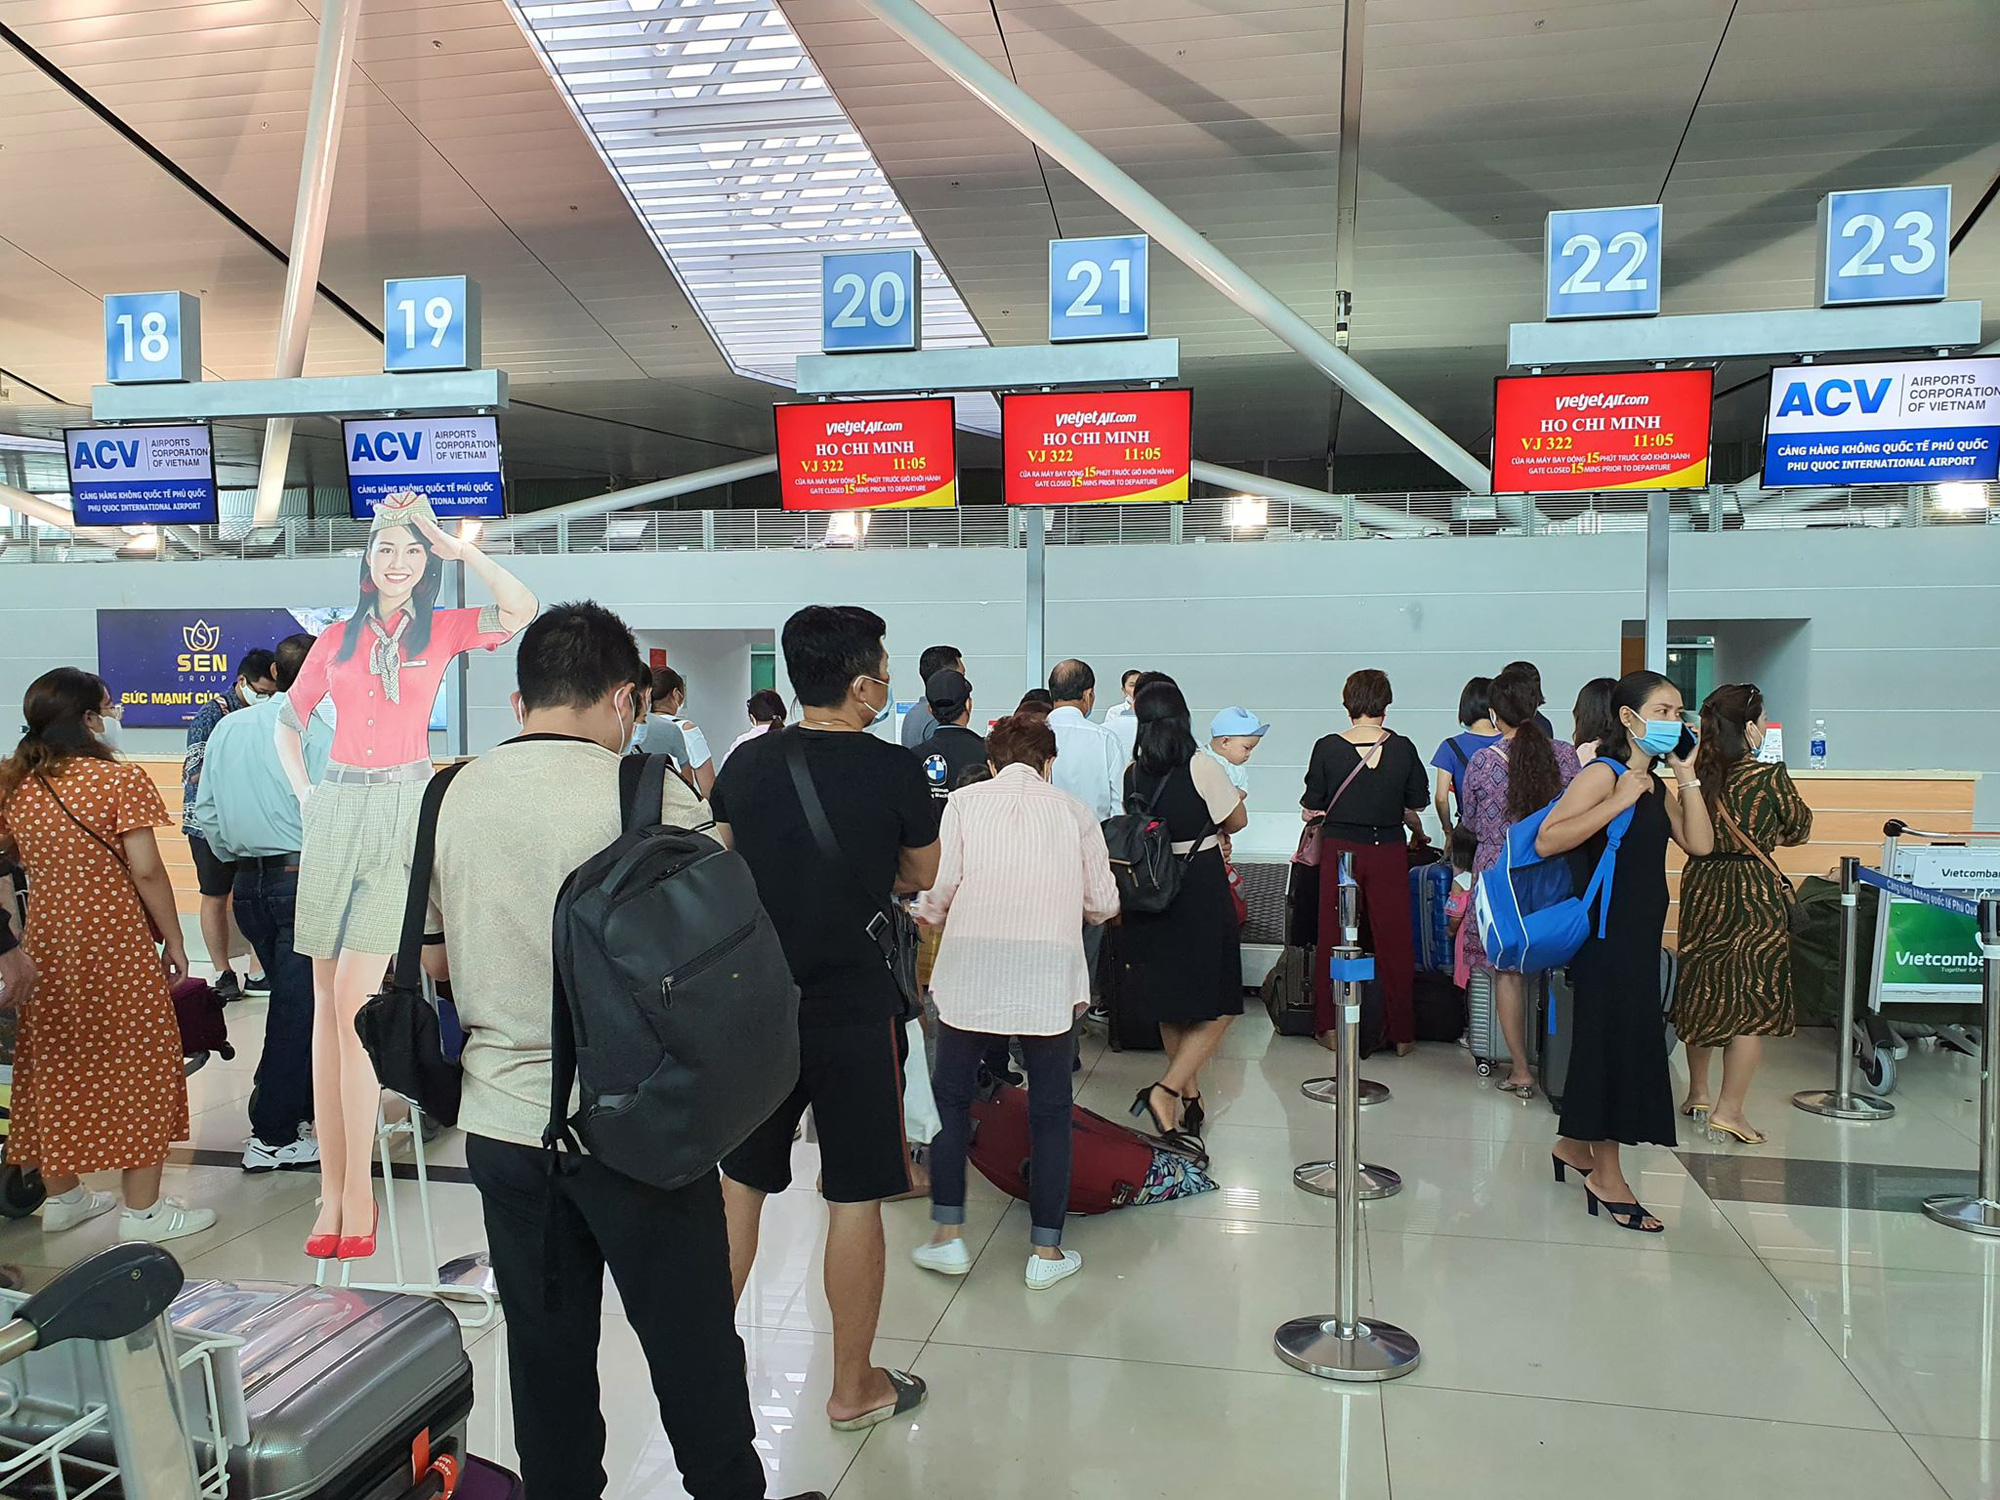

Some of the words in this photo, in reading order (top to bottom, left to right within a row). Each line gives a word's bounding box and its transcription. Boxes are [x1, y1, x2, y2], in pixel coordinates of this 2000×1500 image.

[1838, 210, 1936, 277] 23
[1559, 231, 1649, 294] 22
[1065, 259, 1132, 317] 21
[831, 271, 905, 328] 20
[397, 297, 453, 349] 19
[116, 312, 170, 363] 18
[1911, 375, 1975, 386] AIRPORTS
[1776, 378, 1892, 417] ACV
[1910, 387, 2000, 399] CORPORATION
[1908, 402, 1925, 412] OF
[1929, 400, 1986, 411] VIETNAM
[1541, 419, 1567, 432] HO
[1572, 418, 1604, 431] CHI
[1610, 416, 1661, 430] MINH
[435, 430, 476, 438] AIRPORTS
[1043, 433, 1067, 445] HO
[1071, 432, 1100, 445] CHI
[1105, 431, 1149, 444] MINH
[152, 439, 190, 447] AIRPORTS
[352, 431, 422, 462] ACV
[436, 440, 495, 449] CORPORATION
[816, 444, 838, 456] HO
[842, 443, 868, 455] CHI
[873, 441, 914, 453] MINH
[1521, 438, 1541, 450] VJ
[1547, 436, 1572, 449] 322
[1633, 433, 1674, 447] 11:05
[74, 440, 139, 469] ACV
[152, 448, 208, 457] CORPORATION
[450, 451, 486, 459] VIETNAM
[1027, 450, 1046, 462] VJ
[1050, 450, 1073, 462] 322
[1125, 448, 1161, 460] 11:05
[1587, 452, 1600, 463] 15
[801, 461, 818, 472] VJ
[822, 460, 844, 471] 322
[893, 458, 926, 469] 11:05
[1546, 466, 1570, 474] CLOSED
[1570, 463, 1584, 474] 15
[1787, 461, 1808, 471] PHU
[1811, 460, 1839, 472] QUOC
[1841, 458, 1926, 469] INTERNATIONAL
[1928, 456, 1976, 466] AIRPORT
[1071, 477, 1082, 487] 15
[102, 505, 119, 513] QUOC
[177, 654, 227, 672] SEN
[121, 690, 148, 704] SỨC
